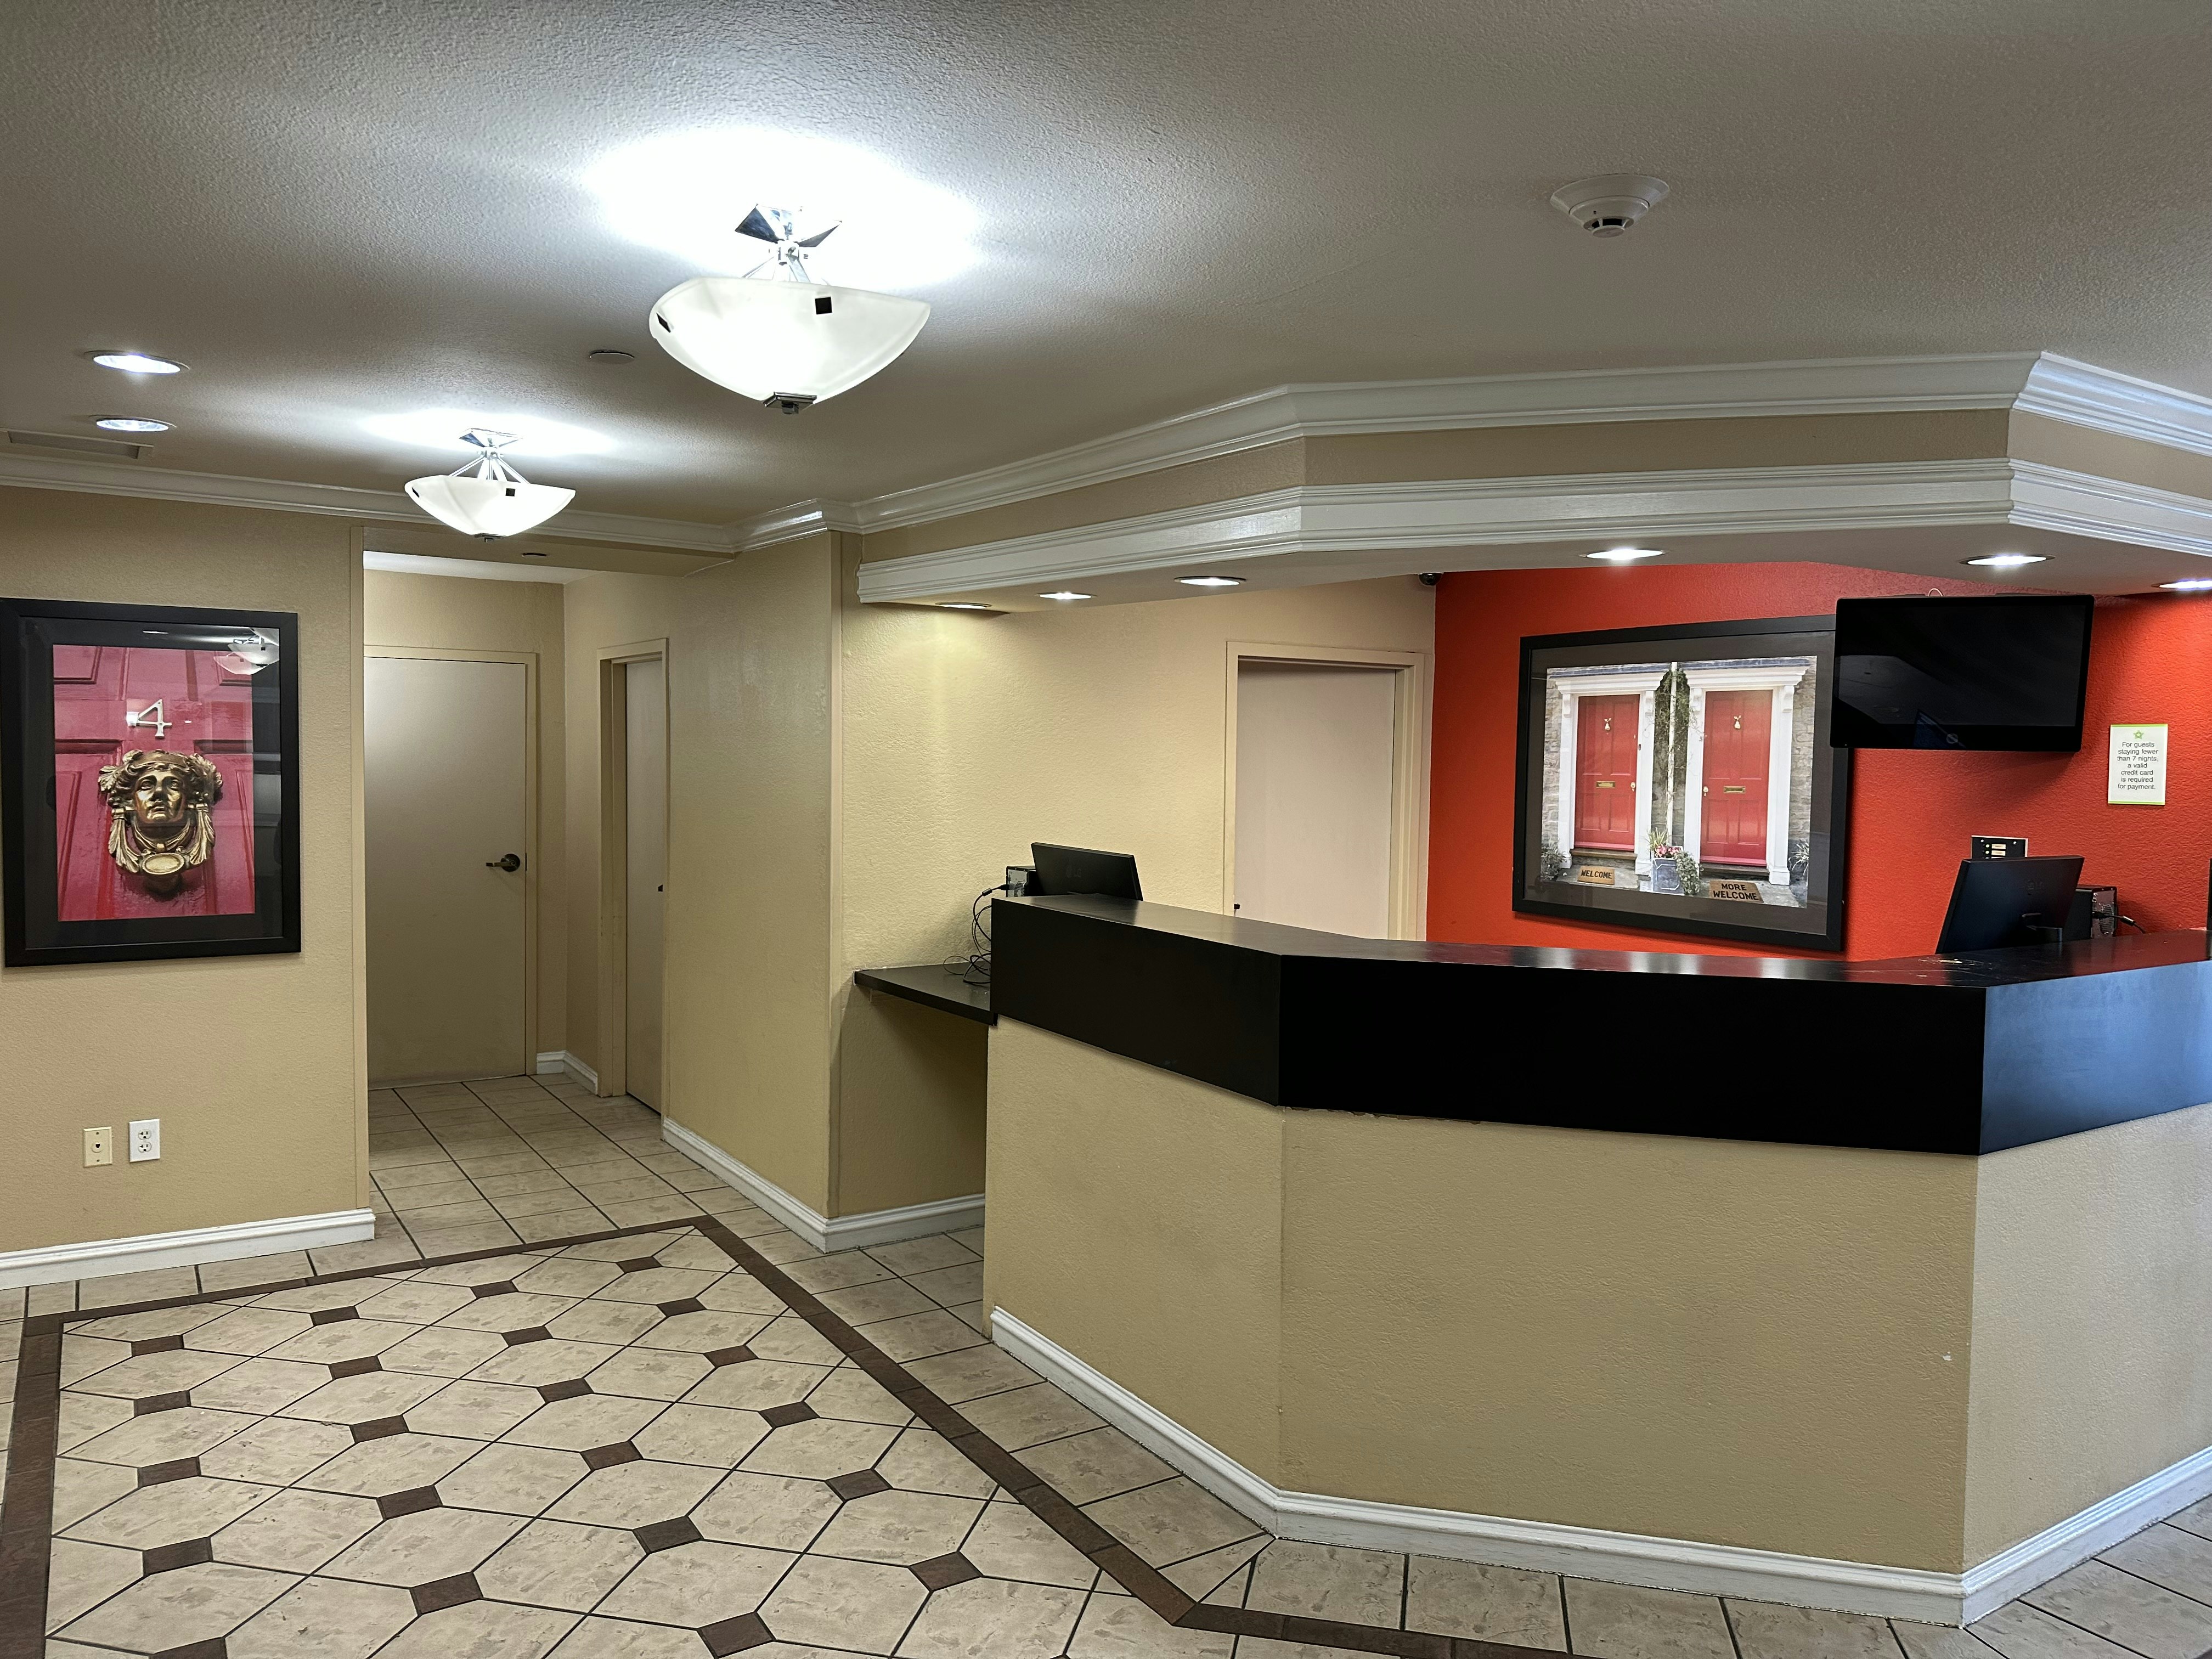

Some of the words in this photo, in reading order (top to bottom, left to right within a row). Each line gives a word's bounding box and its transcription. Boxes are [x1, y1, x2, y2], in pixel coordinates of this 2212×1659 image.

[137, 699, 172, 737] 4
[1581, 870, 1613, 879] WELCOME
[1713, 890, 1758, 900] WELCOME
